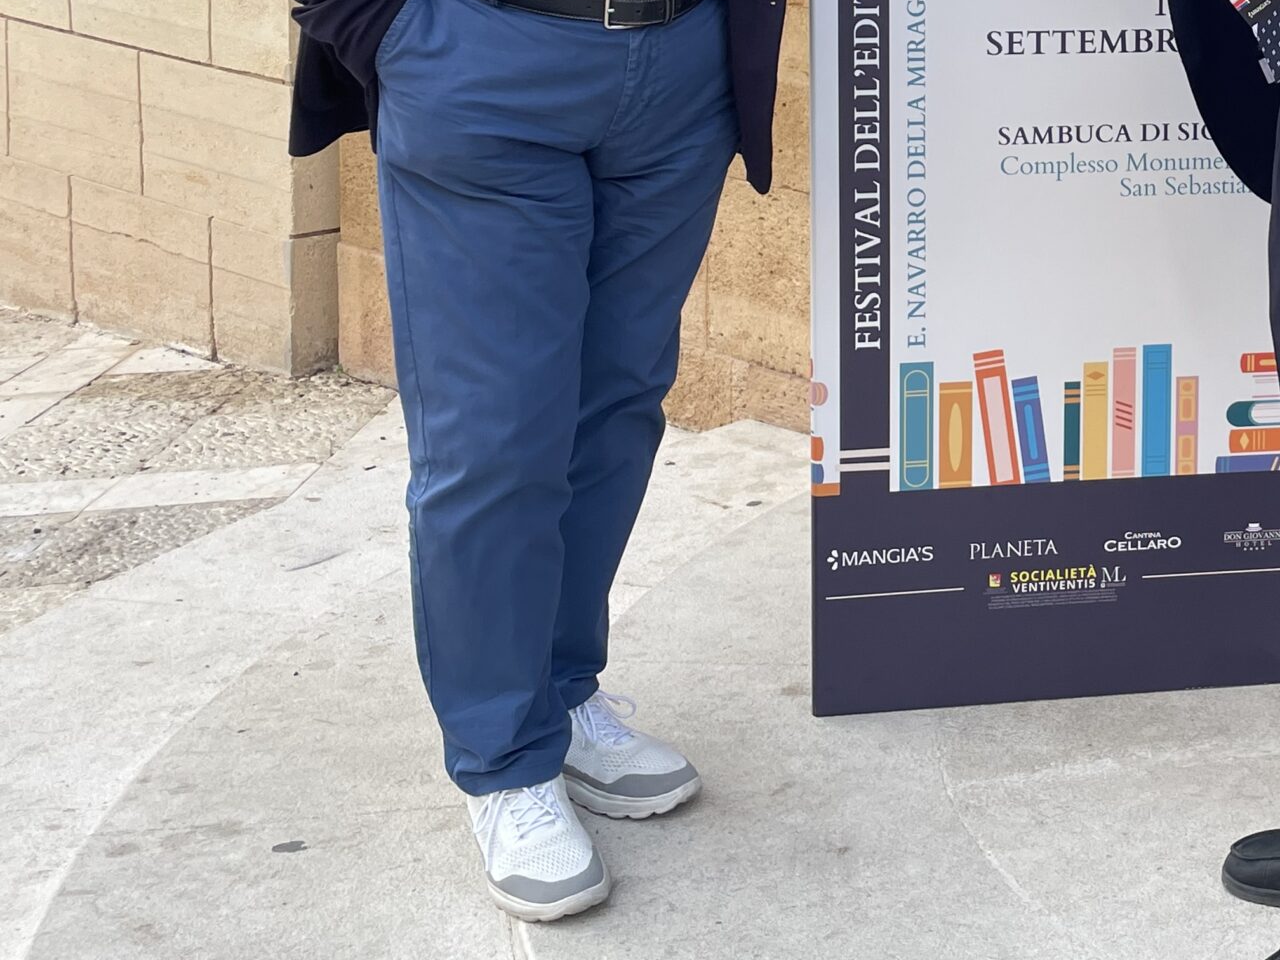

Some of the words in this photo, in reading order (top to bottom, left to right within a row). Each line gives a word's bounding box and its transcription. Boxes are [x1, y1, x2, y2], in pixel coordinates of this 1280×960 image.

[986, 28, 1179, 56] SETTEMBR
[906, 95, 926, 180] DELLA
[998, 124, 1133, 145] SAMBUCA
[1140, 123, 1169, 142] DI
[1177, 122, 1213, 141] SIC
[1000, 152, 1119, 182] Complesso
[1119, 178, 1156, 198] San
[906, 187, 927, 319] NAVARRO
[854, 181, 882, 352] FESTIVAL
[907, 326, 927, 349] E.
[1104, 537, 1182, 552] CELLARO
[1224, 533, 1242, 541] DON
[969, 539, 1058, 560] PLANETA
[1010, 564, 1097, 583] SOCIALIETÀ
